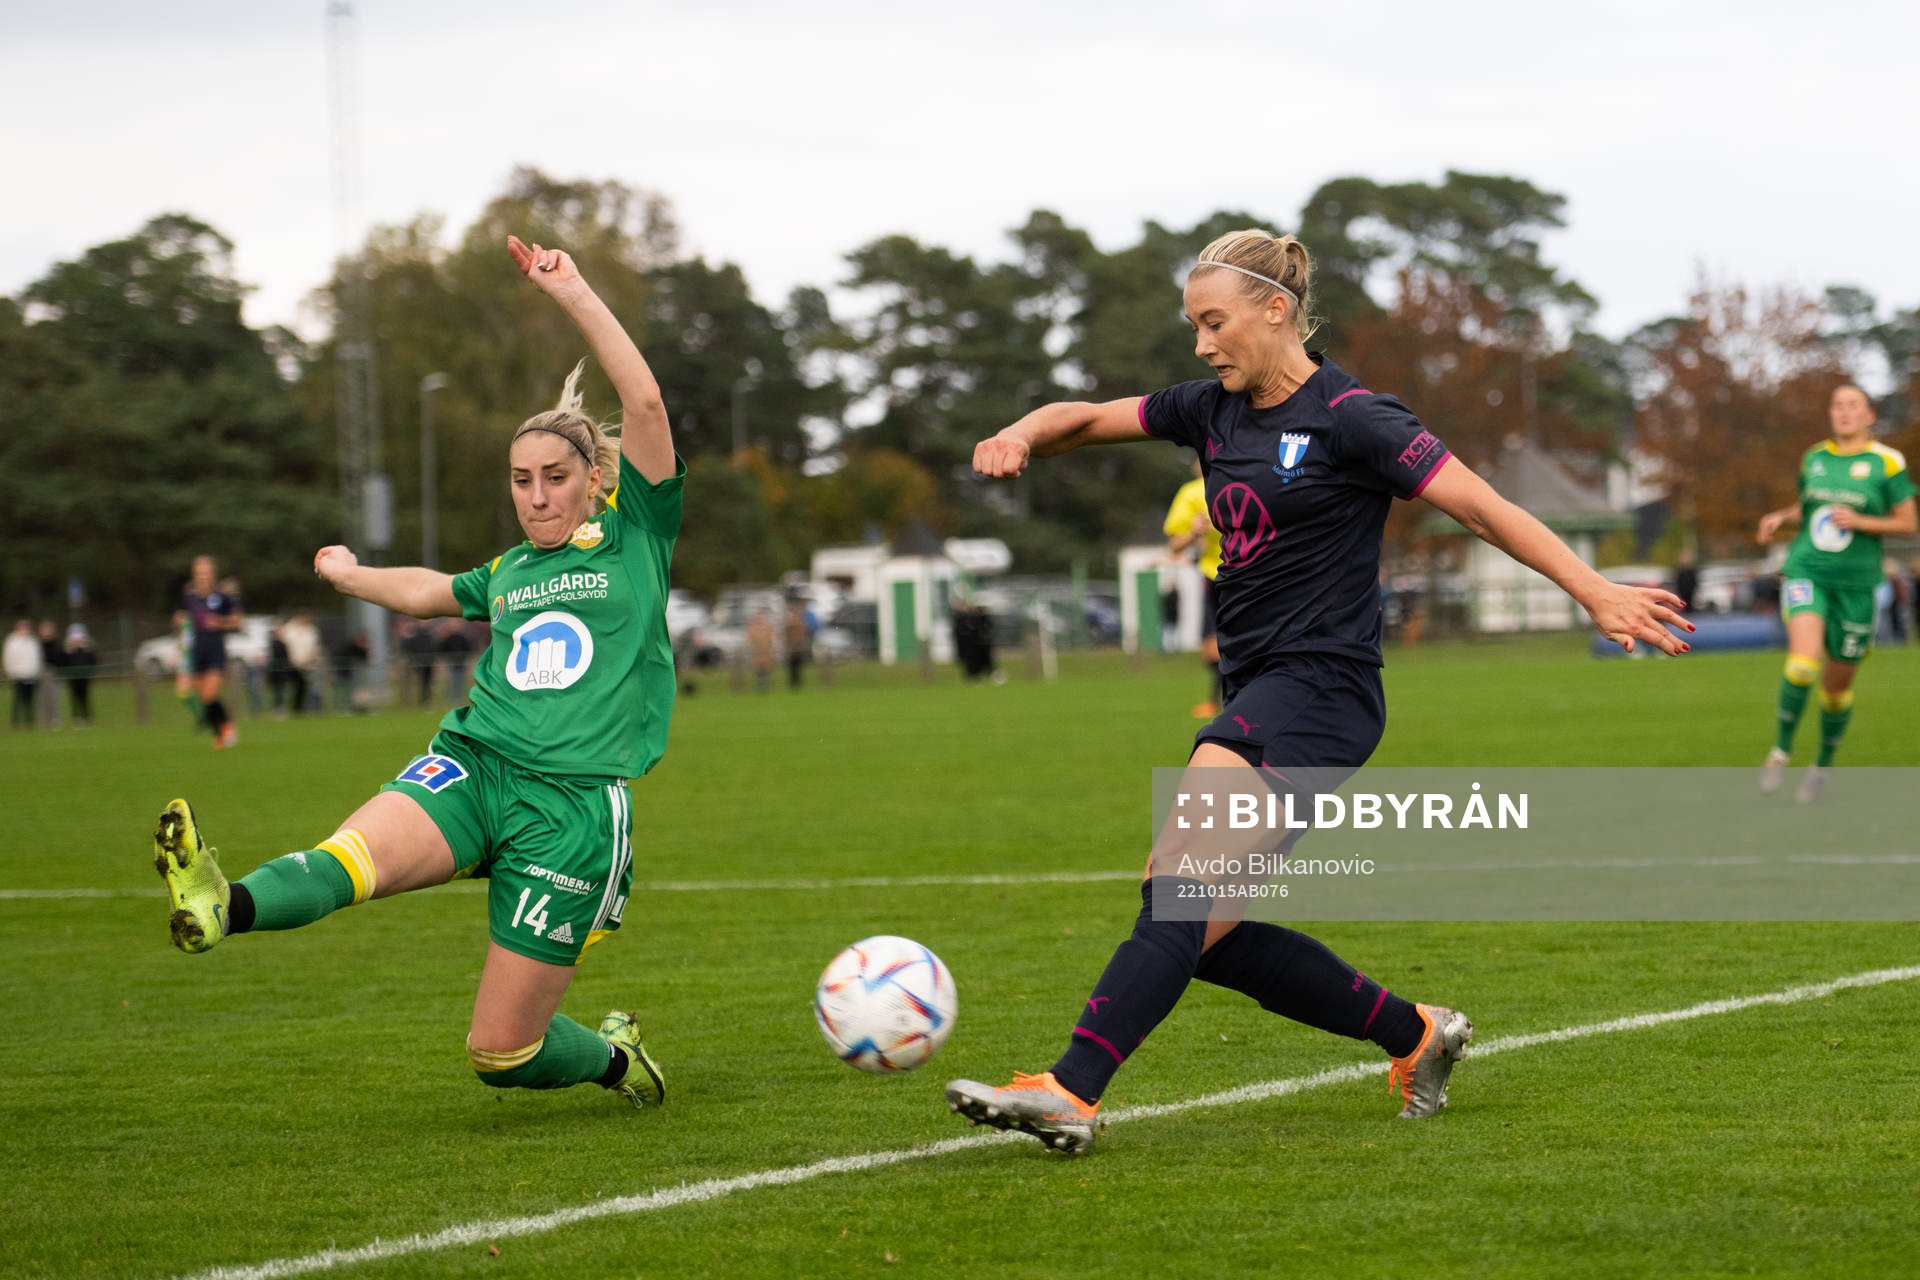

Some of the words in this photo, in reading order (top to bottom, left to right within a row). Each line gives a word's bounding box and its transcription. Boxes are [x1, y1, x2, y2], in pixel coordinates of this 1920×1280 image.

[507, 573, 609, 605] WALLGÅRDS
[525, 670, 562, 687] ABK
[512, 888, 552, 936] 14
[548, 932, 574, 944] adidas
